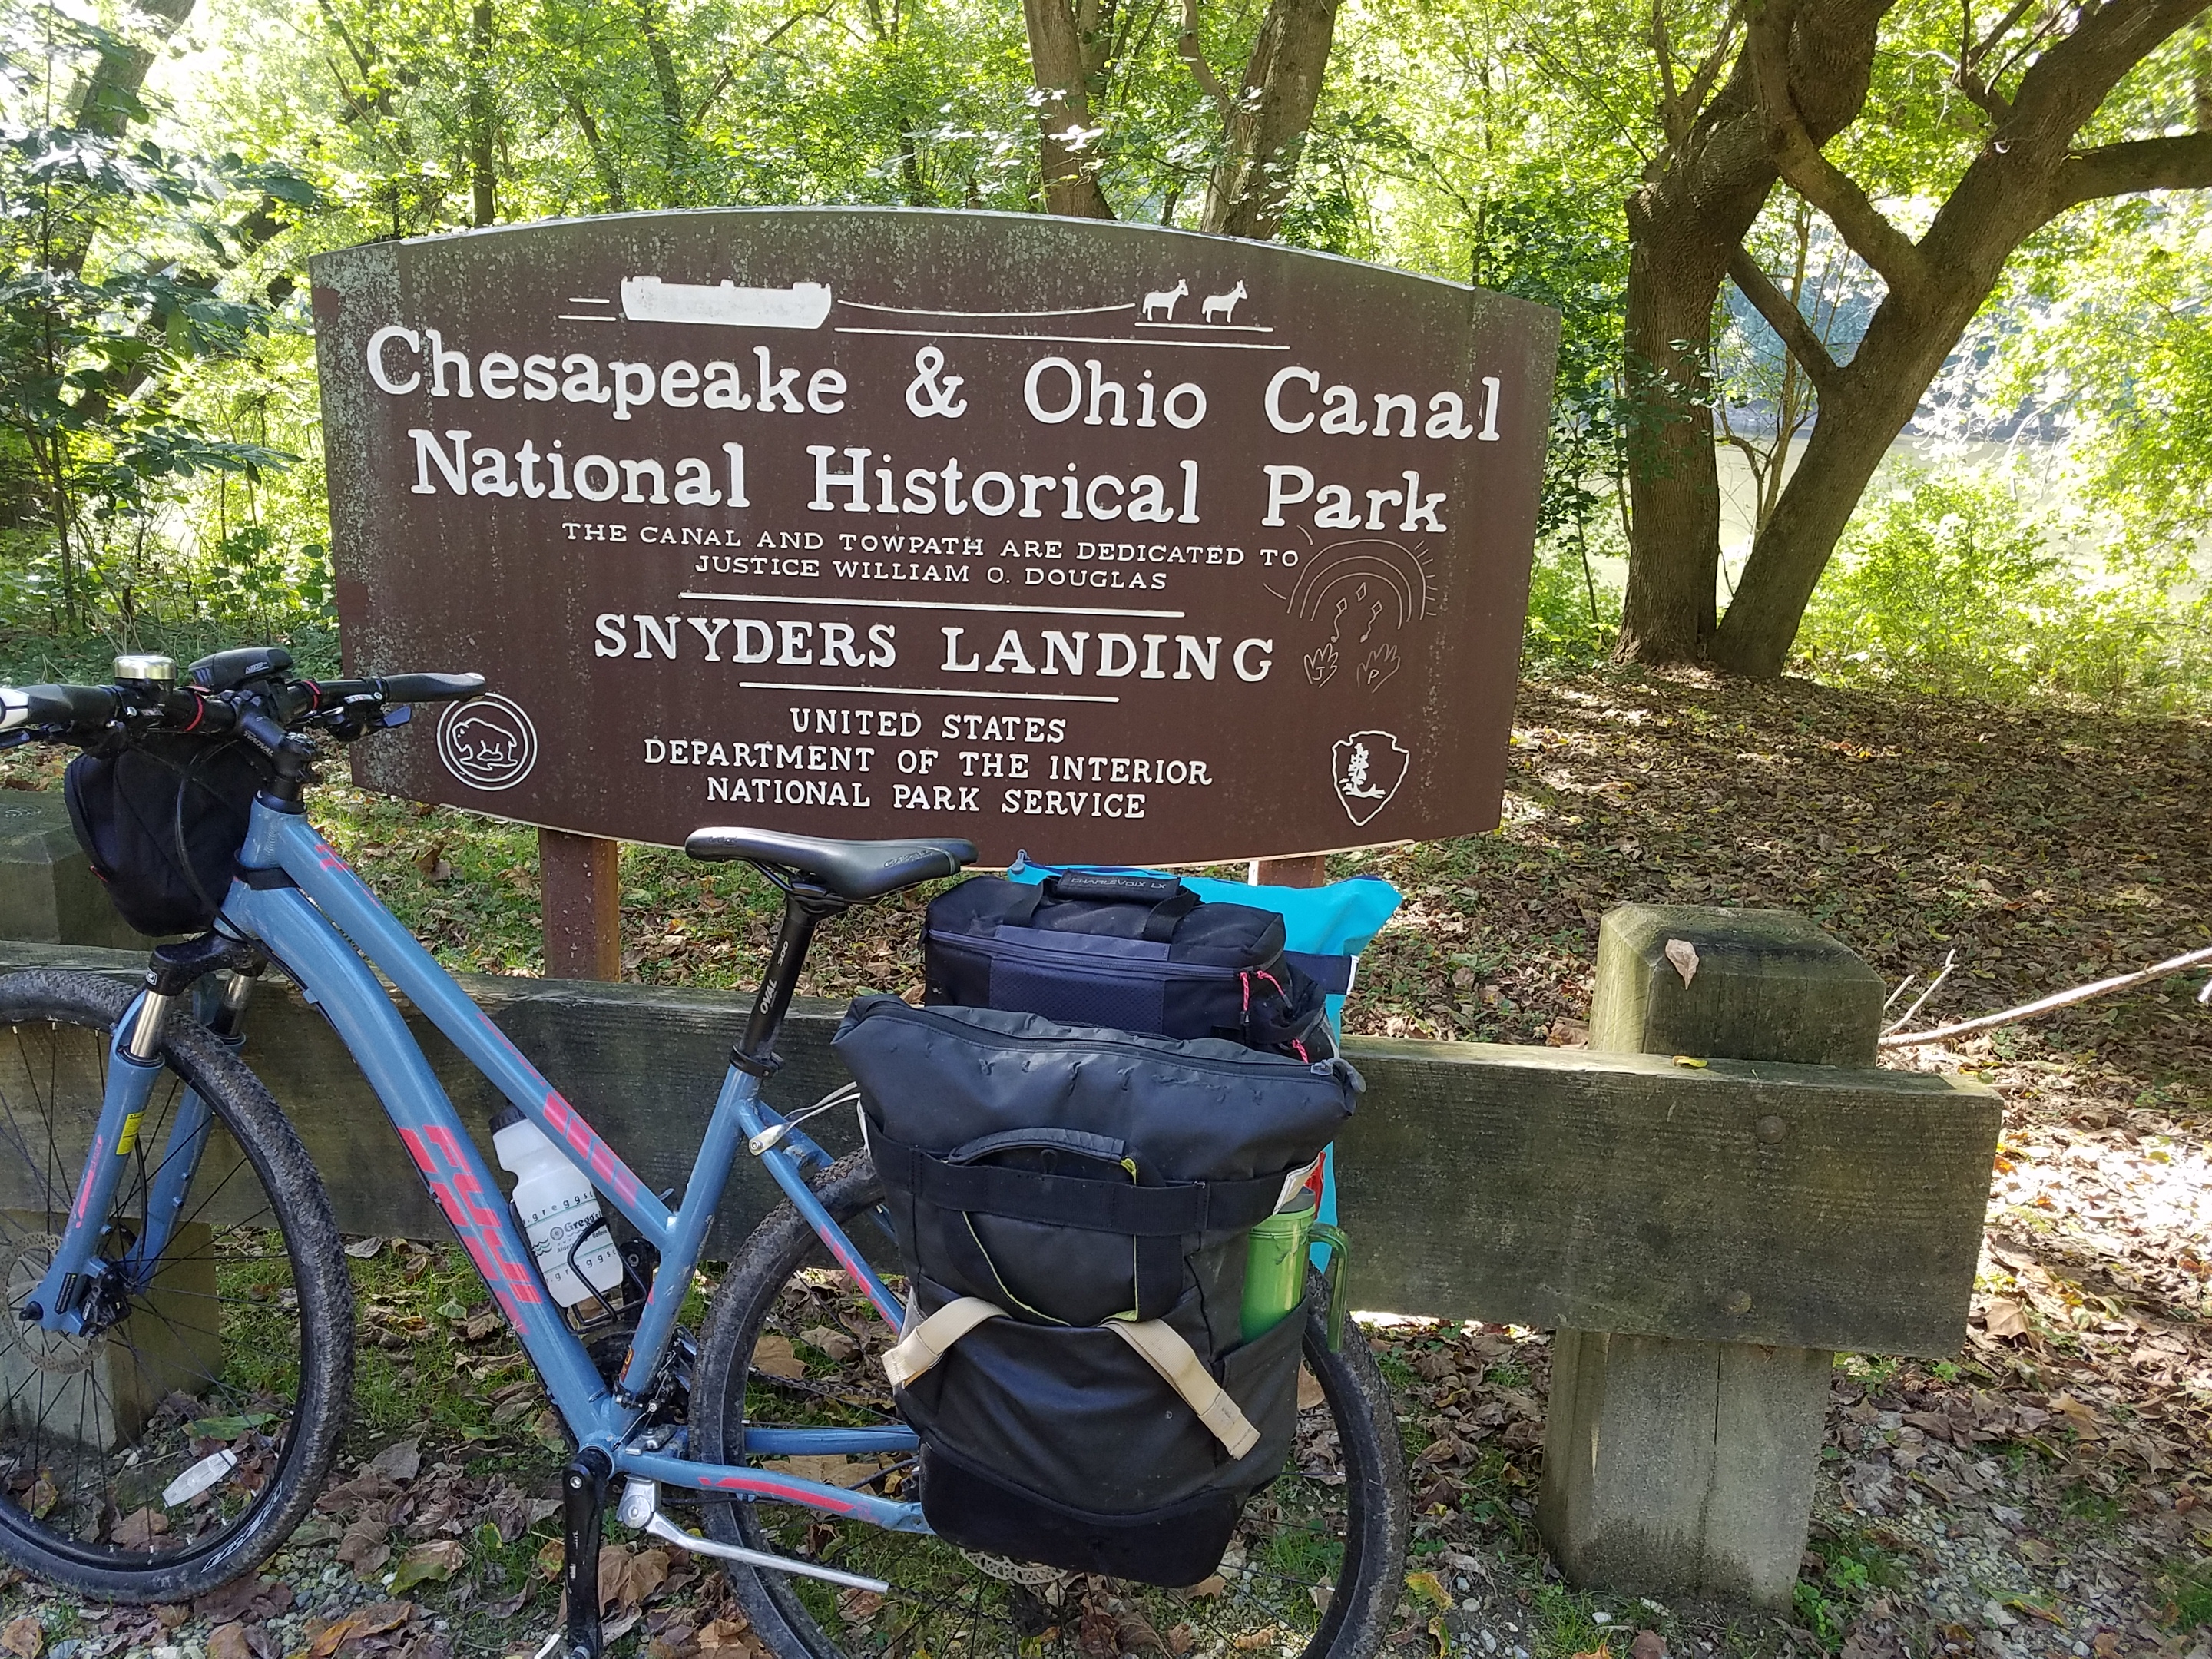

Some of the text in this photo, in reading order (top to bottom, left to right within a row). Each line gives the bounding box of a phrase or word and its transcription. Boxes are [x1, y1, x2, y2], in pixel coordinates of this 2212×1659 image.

[366, 325, 1500, 441] Chesapeake & Ohio Canal
[408, 429, 1447, 532] National Historical Park
[562, 523, 1298, 566] THE CANAL AND TOWPATH ARE DEDICATED TO
[696, 556, 1166, 589] JUSTICE WILLIAM O. DOUGLAS
[595, 614, 1272, 681] SNYDERS LANDING
[790, 708, 1065, 743] UNITED STATES
[644, 739, 1212, 785] DEPARTMENT OF THE INTERIOR
[707, 777, 1145, 818] NATIONAL PARK SERVICE
[1071, 878, 1146, 887] CHARLEVOIX
[760, 979, 777, 1015] OVAL
[423, 1126, 542, 1303] FUJI
